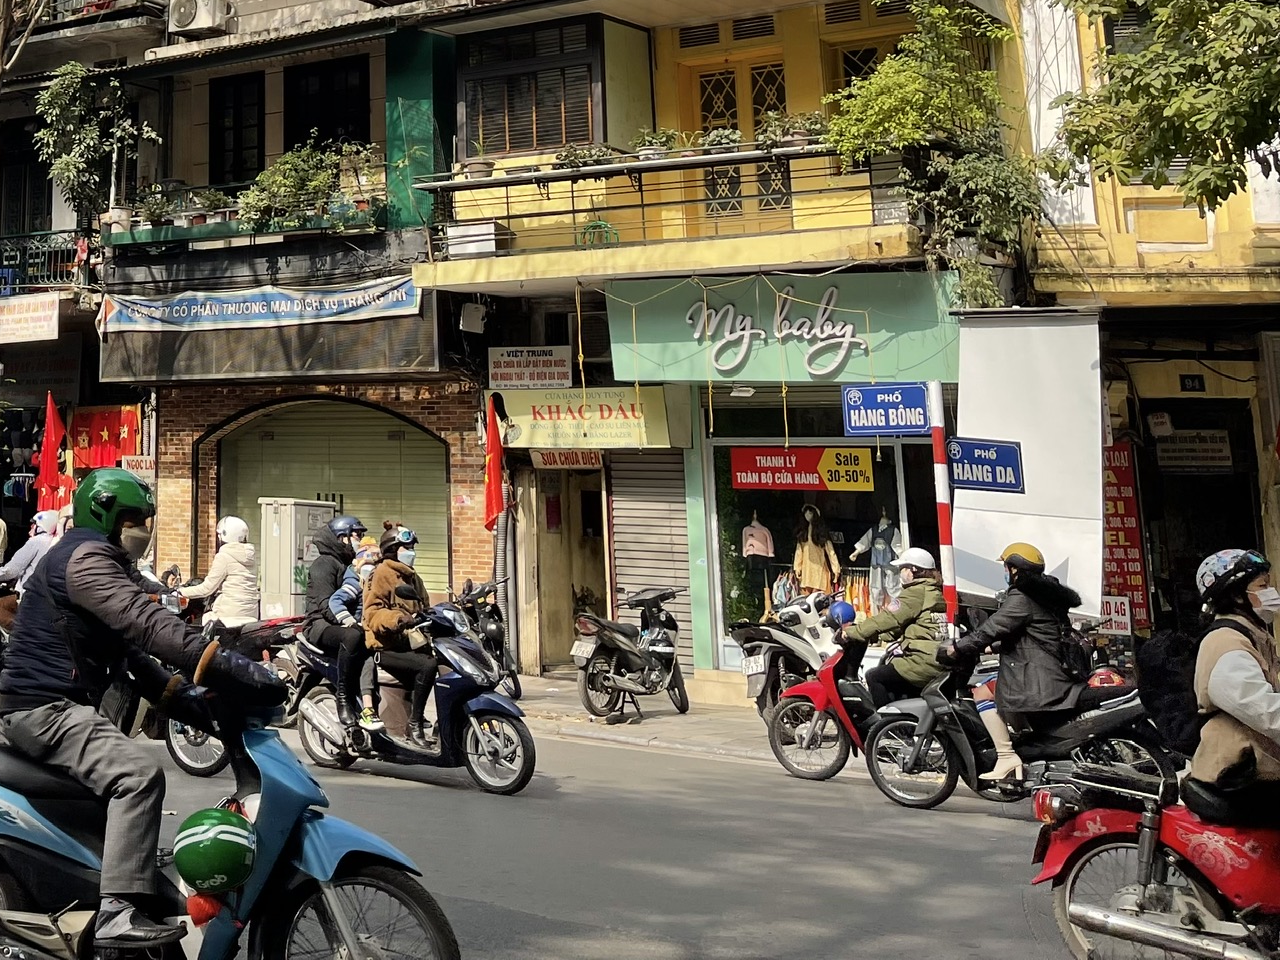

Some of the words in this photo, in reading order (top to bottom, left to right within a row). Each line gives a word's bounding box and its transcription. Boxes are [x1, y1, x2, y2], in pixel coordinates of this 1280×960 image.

[159, 306, 171, 317] TY
[222, 301, 267, 315] THƯƠNG
[271, 301, 290, 315] MẠI
[294, 299, 320, 314] DỊCH
[324, 298, 338, 312] VỤ
[685, 301, 766, 370] My
[773, 285, 867, 375] baby
[506, 349, 524, 358] VIỆT
[526, 349, 553, 357] TRUNG
[1185, 378, 1199, 389] 94
[877, 390, 902, 403] PHỐ
[531, 401, 592, 420] KHẮC
[598, 399, 645, 420] DẤU
[850, 406, 886, 427] HÀNG
[888, 405, 924, 426] BÔNG
[541, 451, 558, 466] SỬA
[582, 450, 601, 467] ĐIỆN
[835, 453, 860, 466] Sale
[974, 447, 997, 460] PHỐ
[126, 459, 143, 472] NGỌC
[755, 456, 784, 467] THANH
[786, 454, 797, 467] LÝ
[1111, 451, 1128, 470] LOẠI
[736, 470, 759, 483] TOÀN
[761, 471, 772, 486] BỘ
[774, 469, 793, 484] CỬA
[794, 470, 819, 484] HÀNG
[827, 470, 870, 483] 30-50%
[953, 460, 992, 482] HÀNG
[996, 466, 1016, 484] DA
[1121, 486, 1132, 497] 500
[1105, 501, 1125, 514] BI
[1124, 517, 1136, 527] 500
[1105, 531, 1131, 546] EL
[1127, 548, 1139, 559] 500
[1123, 562, 1141, 572] 100
[1126, 575, 1142, 585] 100
[1114, 602, 1126, 616] 4G
